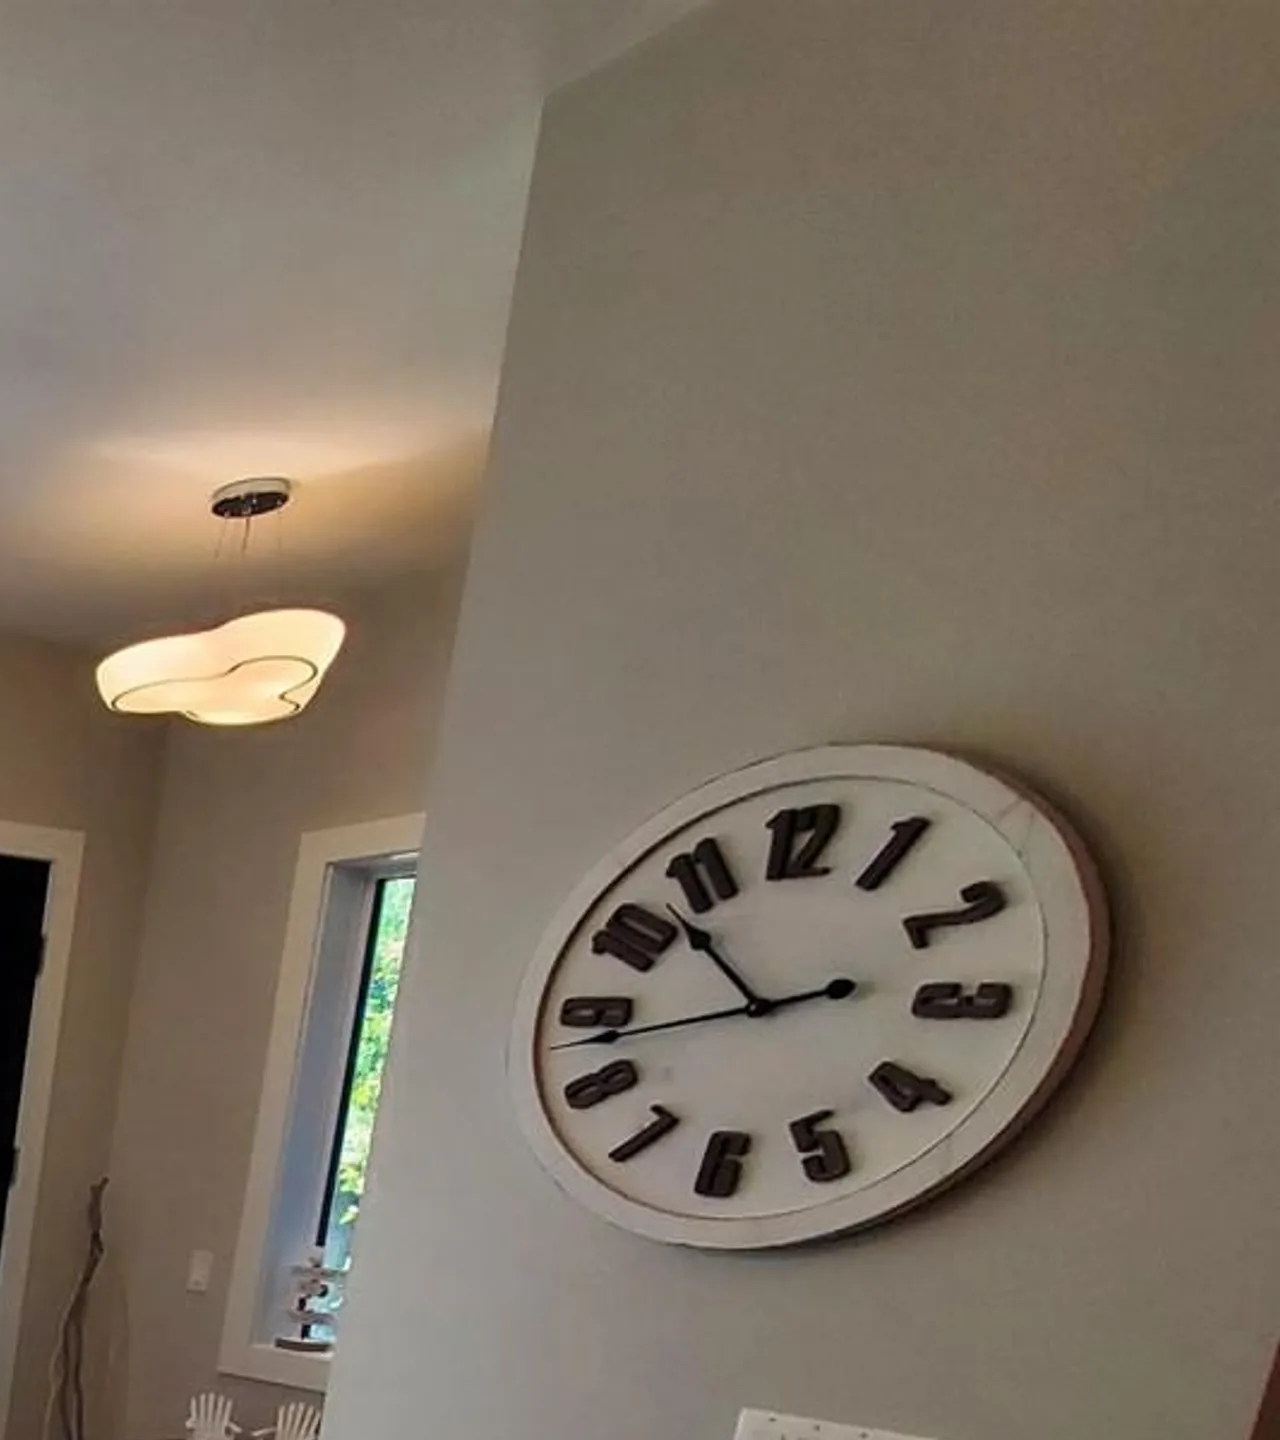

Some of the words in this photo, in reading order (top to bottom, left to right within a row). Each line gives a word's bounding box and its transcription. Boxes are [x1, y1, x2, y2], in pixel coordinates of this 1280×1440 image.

[666, 837, 739, 914] 11
[765, 803, 840, 881] 12
[855, 815, 931, 891] 1
[592, 902, 678, 972] 10
[903, 881, 1008, 949] 2
[560, 996, 635, 1028] 9
[912, 982, 1013, 1019] 3
[563, 1058, 639, 1109] 8
[868, 1060, 953, 1113] 4
[607, 1104, 680, 1163] 7
[694, 1130, 751, 1199] 6
[789, 1109, 851, 1183] 5
